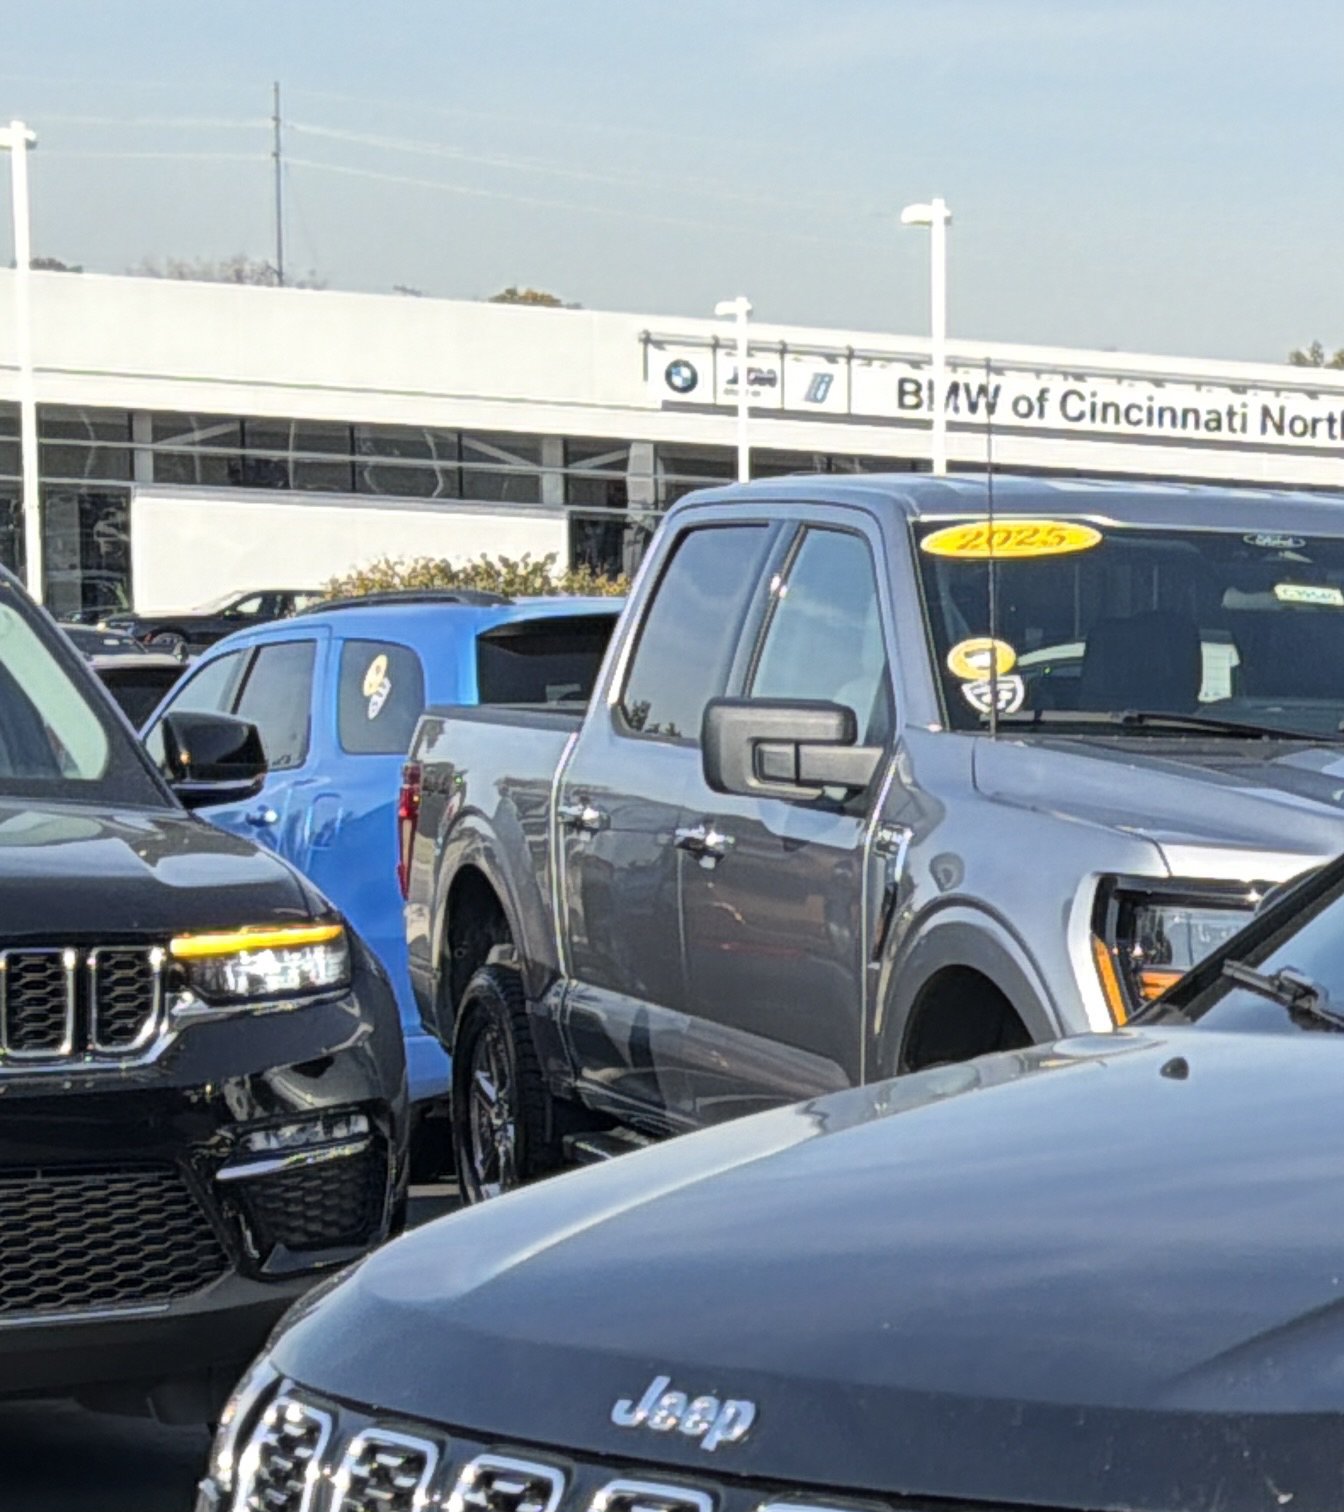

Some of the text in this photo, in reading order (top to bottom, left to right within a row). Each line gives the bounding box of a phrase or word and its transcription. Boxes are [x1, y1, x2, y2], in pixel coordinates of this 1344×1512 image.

[897, 377, 1001, 415] BMW
[1012, 387, 1049, 419] of
[1059, 388, 1248, 434] Cincinnati
[957, 527, 1066, 551] 2025
[611, 1375, 756, 1452] Jeep
